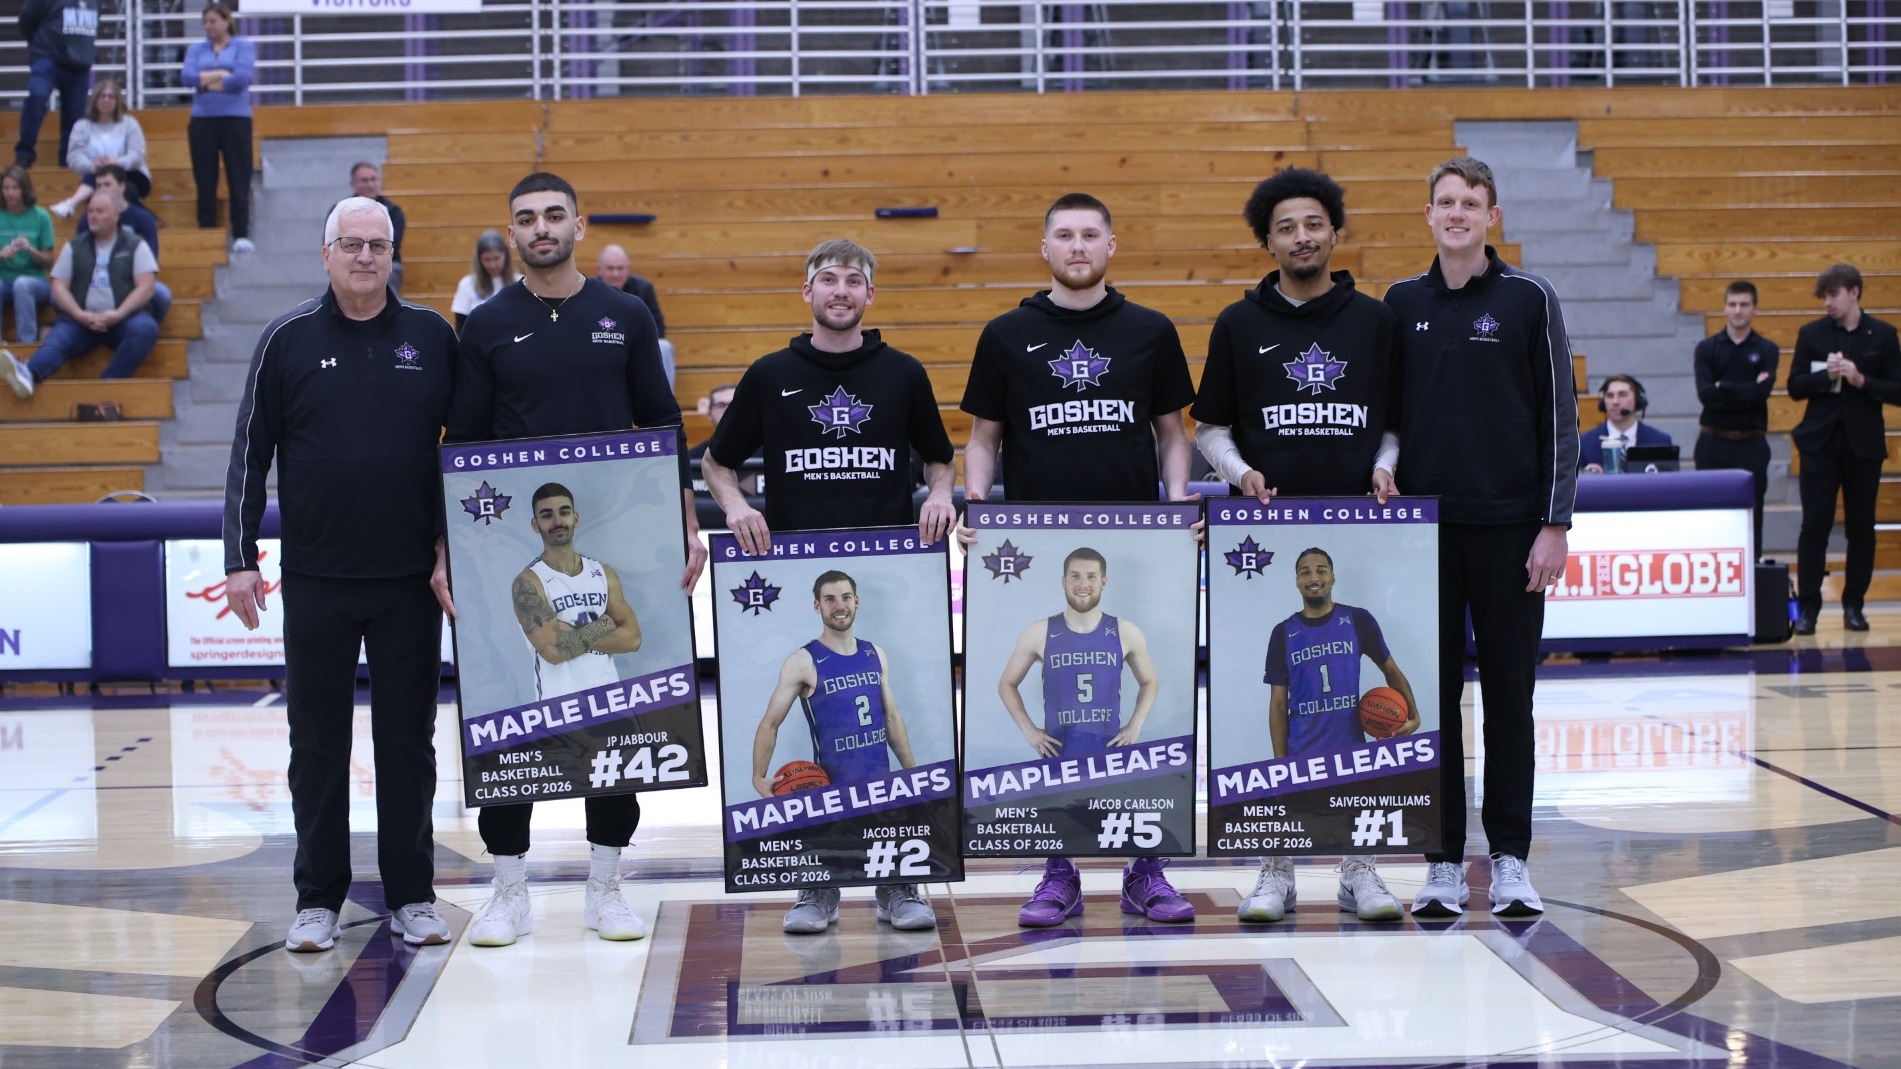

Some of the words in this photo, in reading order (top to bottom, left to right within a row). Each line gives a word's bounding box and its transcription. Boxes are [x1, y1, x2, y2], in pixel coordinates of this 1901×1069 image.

[591, 332, 625, 341] GOSHEN
[1071, 360, 1089, 378] G
[1307, 363, 1325, 382] G
[832, 407, 850, 425] G
[1028, 400, 1135, 430] GOSHEN
[1261, 403, 1368, 430] GOSHEN
[1047, 427, 1071, 437] MEN'S
[1072, 424, 1120, 434] BASKETBALL
[1278, 428, 1303, 436] MEN'S
[1304, 428, 1353, 436] BASKETBALL
[454, 450, 545, 468] GOSHEN
[559, 441, 661, 460] COLLEGE
[785, 447, 896, 473] GOSHEN
[830, 472, 881, 480] BASKETBALL
[479, 498, 495, 515] G
[1220, 509, 1310, 521] GOSHEN
[1323, 508, 1422, 520] COLLEGE
[979, 513, 1069, 525] GOSHEN
[1083, 513, 1182, 525] COLLEGE
[725, 543, 815, 558] GHEN
[1000, 557, 1015, 573] G
[1242, 553, 1257, 570] G
[1611, 552, 1741, 596] GLOBE
[552, 593, 607, 613] GOSHEN
[748, 589, 764, 605] G
[1050, 651, 1117, 669] GOSHEN
[1291, 641, 1354, 666] GOSHEN
[823, 671, 882, 695] GOSHEN
[1319, 664, 1331, 693] 1
[1076, 673, 1093, 703] 5
[469, 699, 583, 747] MAPLE
[587, 672, 690, 718] LEAFS
[855, 694, 873, 726] 2
[1299, 694, 1358, 715] COLLEGE
[607, 736, 618, 748] JP
[619, 731, 669, 746] JABBOUR
[499, 750, 543, 765] MEN'S
[588, 744, 690, 789] #42
[482, 765, 563, 783] BASKETBALL
[969, 759, 1081, 799] MAPLE
[1087, 742, 1187, 779] LEAFS
[1216, 757, 1329, 798] MAPLE
[1333, 738, 1435, 778] LEAFS
[475, 784, 517, 800] CLASS
[521, 783, 539, 796] OF
[542, 781, 572, 793] 2026
[731, 789, 844, 834] MAPLE
[849, 768, 951, 809] LEAFS
[1088, 799, 1122, 810] JACOB
[1124, 798, 1174, 810] CARLSON
[1329, 796, 1377, 808] SAIVEON
[1378, 795, 1431, 806] WILLIAMS
[995, 807, 1038, 818] MEN'S
[1243, 805, 1286, 817] MEN'S
[863, 827, 897, 840] JACOB
[899, 825, 931, 837] EYLER
[977, 823, 1056, 835] BASKETBALL
[1097, 812, 1163, 849] #5
[1225, 821, 1305, 834] BASKETBALL
[1351, 808, 1409, 847] #1
[759, 839, 803, 852] MEN'S
[969, 839, 1010, 851] CLASS
[1013, 839, 1032, 850] OF
[1034, 839, 1064, 850] 2026
[1217, 838, 1260, 850] CLASS
[1262, 838, 1281, 849] OF
[1283, 837, 1313, 848] 2026
[742, 855, 822, 869] BASKETBALL
[864, 838, 931, 878] #2
[735, 872, 776, 886] CLASS
[780, 872, 798, 884] OF
[801, 870, 831, 882] 2026
